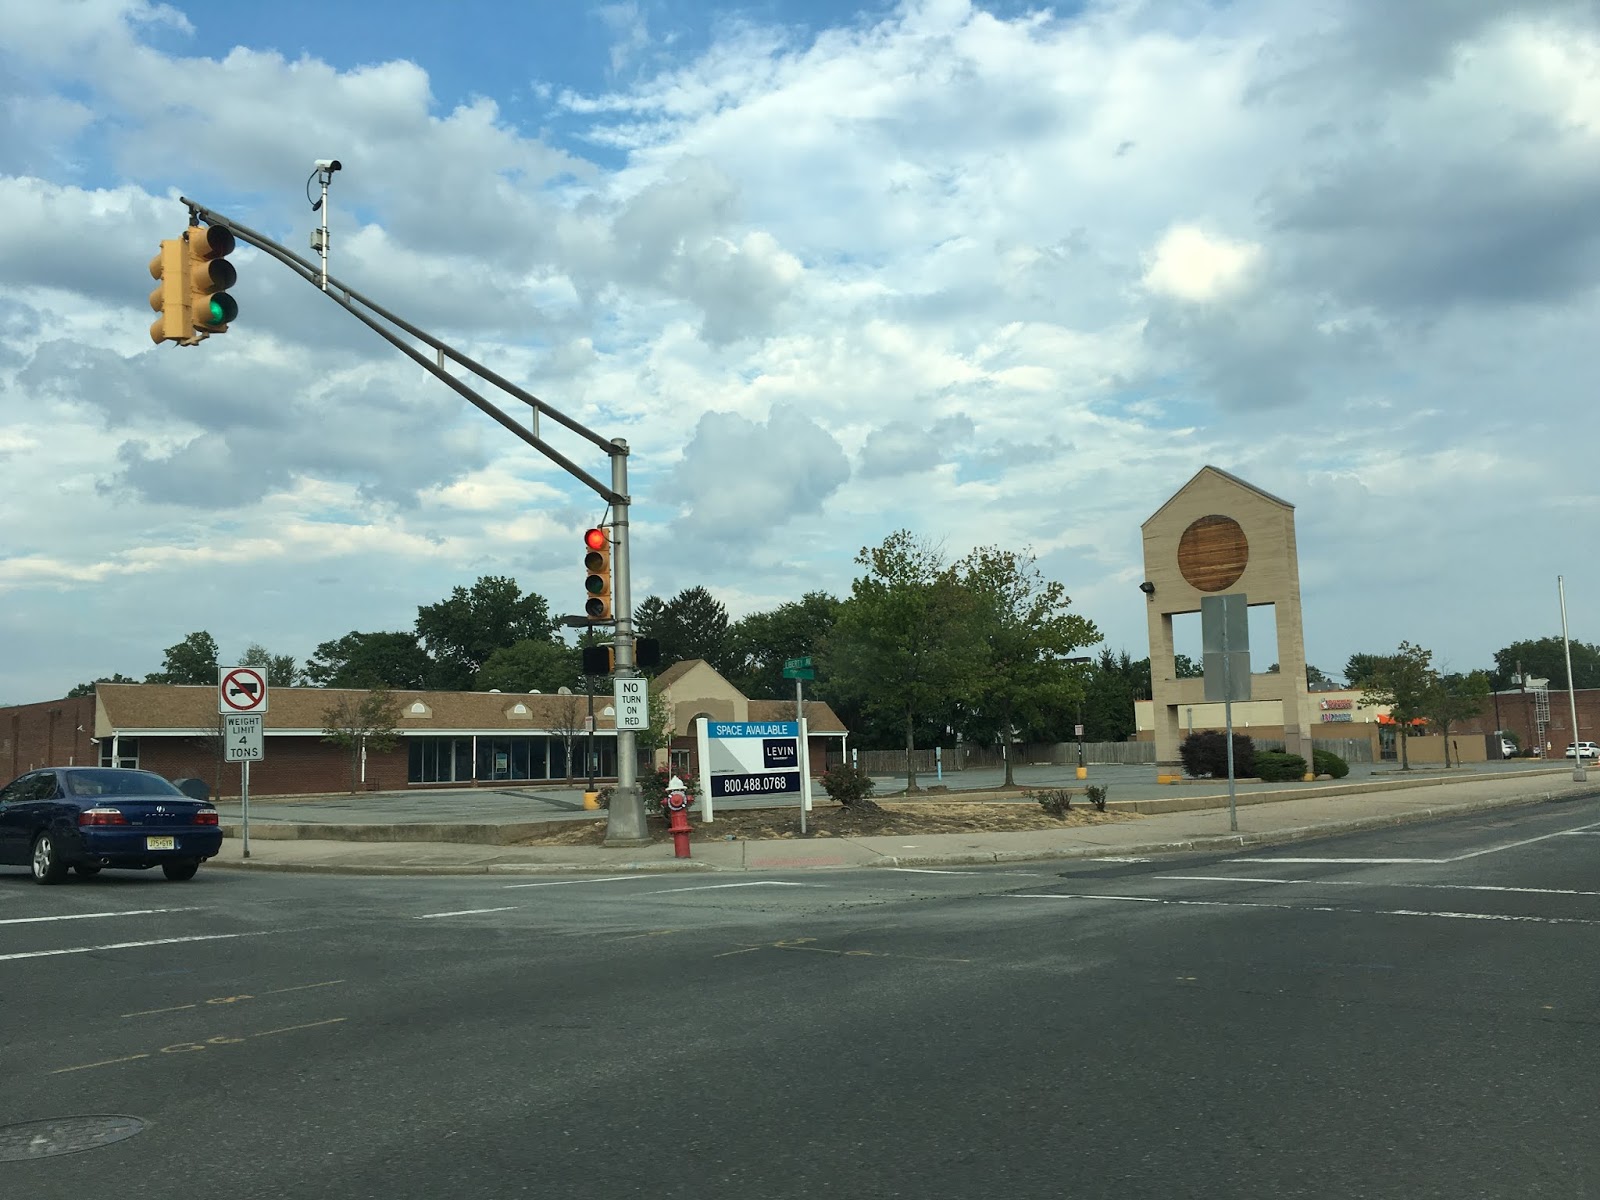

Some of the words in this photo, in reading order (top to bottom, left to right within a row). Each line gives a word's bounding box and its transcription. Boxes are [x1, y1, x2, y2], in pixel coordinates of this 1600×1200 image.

[623, 683, 638, 693] NO
[622, 695, 641, 703] TURN
[626, 706, 637, 714] ON
[228, 718, 260, 726] WEIGHT
[624, 717, 639, 726] RED
[232, 726, 255, 734] LIMIT
[716, 725, 742, 736] SPACE
[745, 724, 788, 735] AVAILABLE
[238, 736, 247, 744] 4
[230, 747, 258, 758] TONS
[766, 746, 794, 756] LEVIN
[724, 776, 787, 793] 800.488.0768
